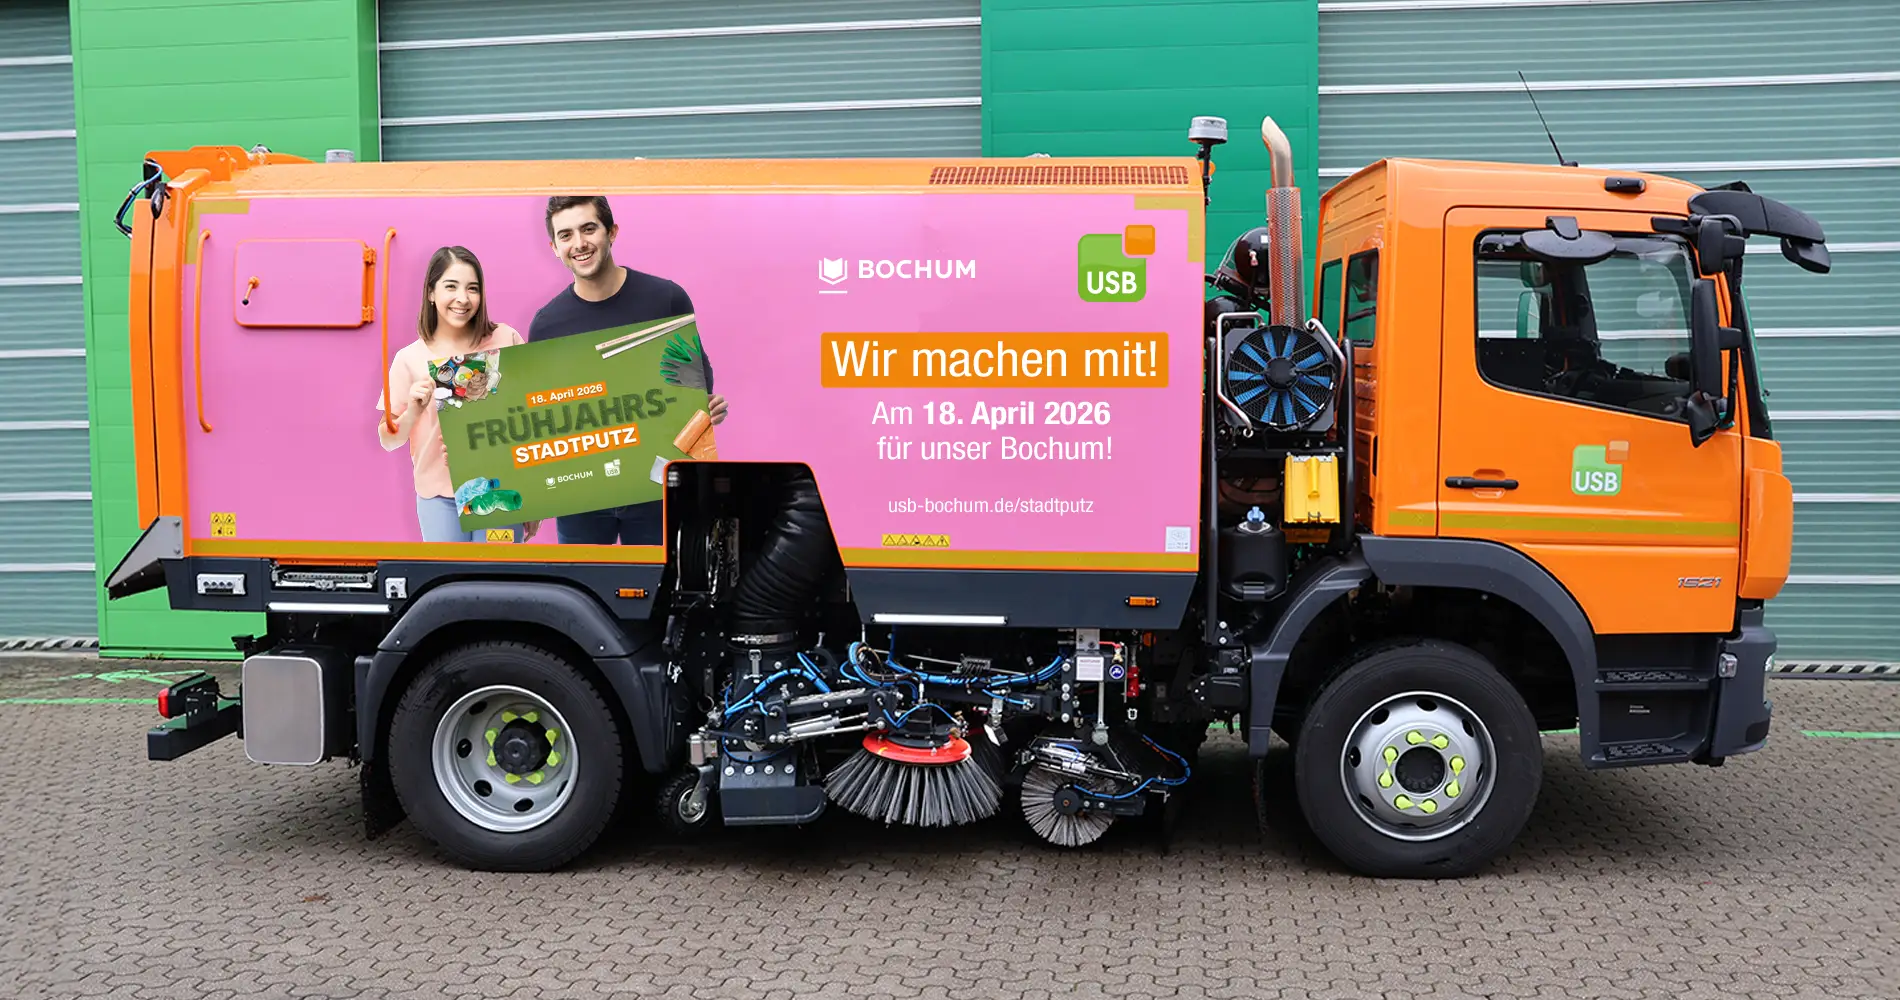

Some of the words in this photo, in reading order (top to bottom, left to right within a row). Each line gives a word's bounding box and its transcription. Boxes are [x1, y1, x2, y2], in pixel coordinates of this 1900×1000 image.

[858, 259, 976, 279] BOCHUM
[1086, 270, 1137, 295] USB
[831, 341, 897, 377] Wir
[912, 341, 1067, 377] machen
[1084, 341, 1157, 377] mit!
[530, 395, 547, 404] 18.
[549, 390, 575, 402] April
[576, 383, 603, 396] 2026
[466, 388, 678, 450] FRÜHJAHRS-
[871, 401, 913, 425] Am
[923, 401, 964, 425] 18.
[970, 401, 1034, 430] April
[1044, 401, 1111, 425] 2026
[515, 427, 637, 464] STADTPUTZ
[876, 435, 913, 460] für
[921, 441, 992, 460] unser
[1000, 436, 1112, 460] Bochum!
[557, 470, 593, 483] BOCHUM
[606, 468, 619, 476] USB
[1575, 471, 1618, 492] USB
[887, 497, 1094, 517] usb-bochum.de/stadtputz
[1677, 576, 1722, 589] 1521
